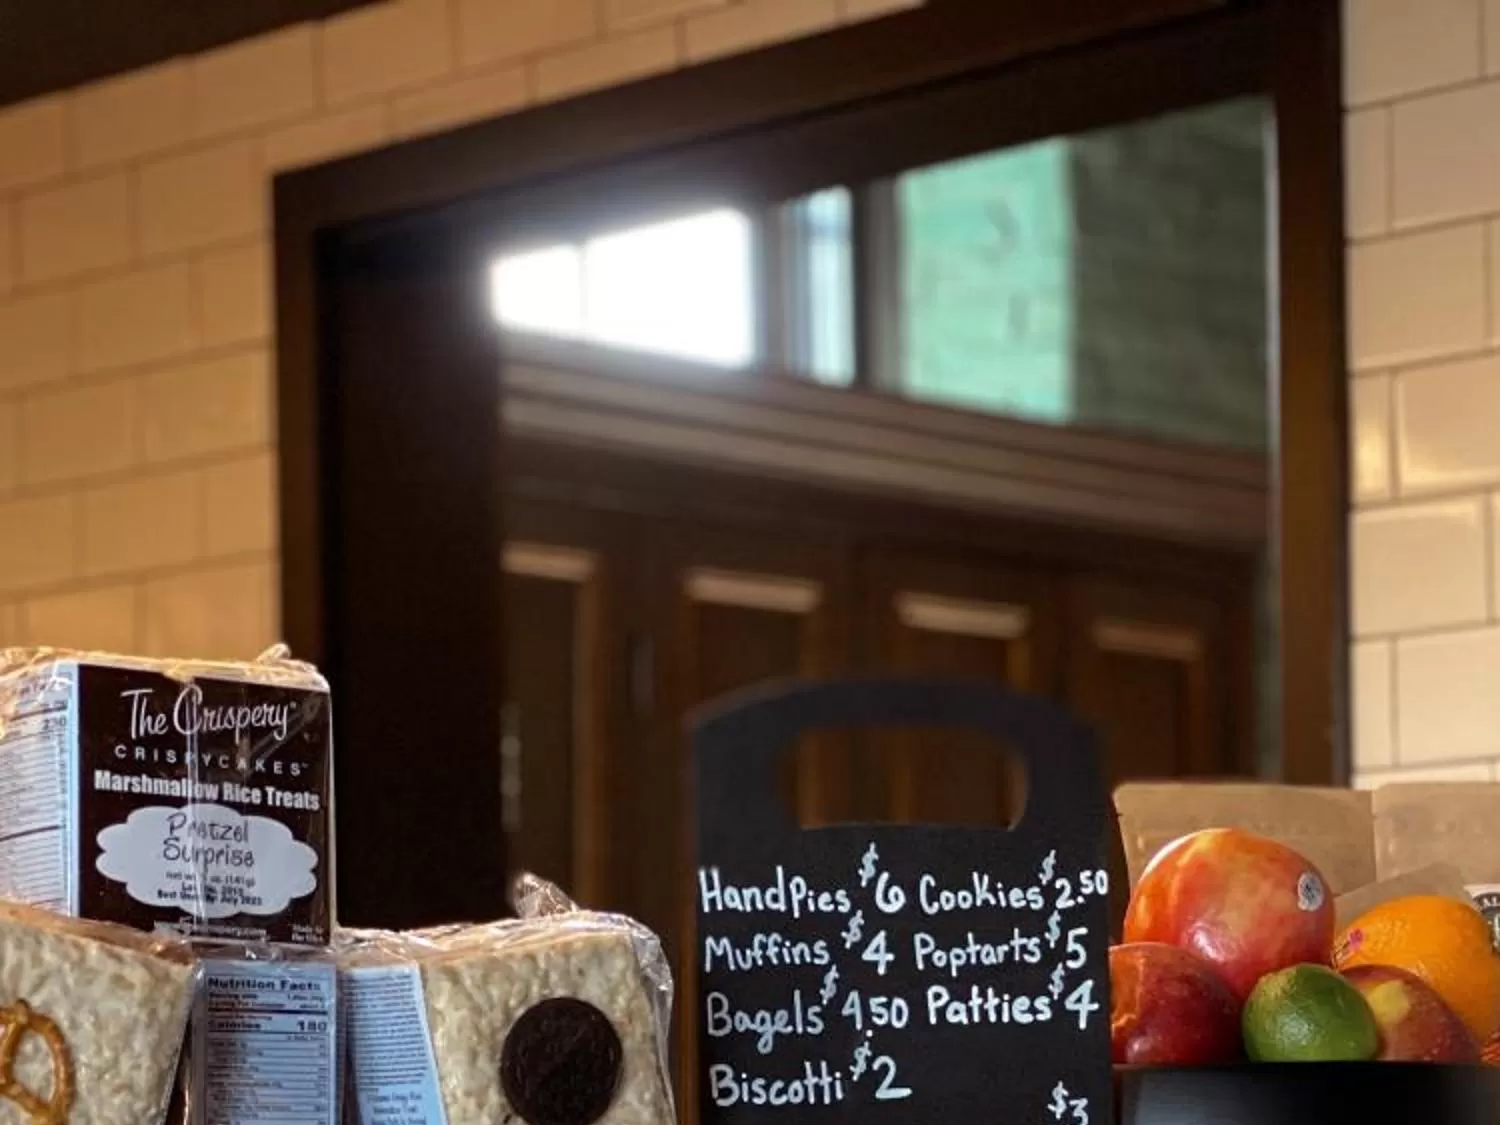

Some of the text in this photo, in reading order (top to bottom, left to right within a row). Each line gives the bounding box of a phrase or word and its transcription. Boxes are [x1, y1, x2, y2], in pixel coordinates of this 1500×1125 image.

[120, 688, 169, 740] The
[94, 769, 321, 812] Marshmallow Rice Treats
[165, 812, 249, 844] Pretzel
[162, 837, 256, 875] Surprise
[919, 871, 1045, 915] Cookies
[705, 932, 831, 973] Muffins
[913, 927, 1042, 978] Poptarts
[207, 977, 321, 991] Nutrition Facts
[926, 984, 1053, 1026] Patties
[707, 988, 825, 1055] Bagels
[709, 1060, 845, 1107] Biscotti
